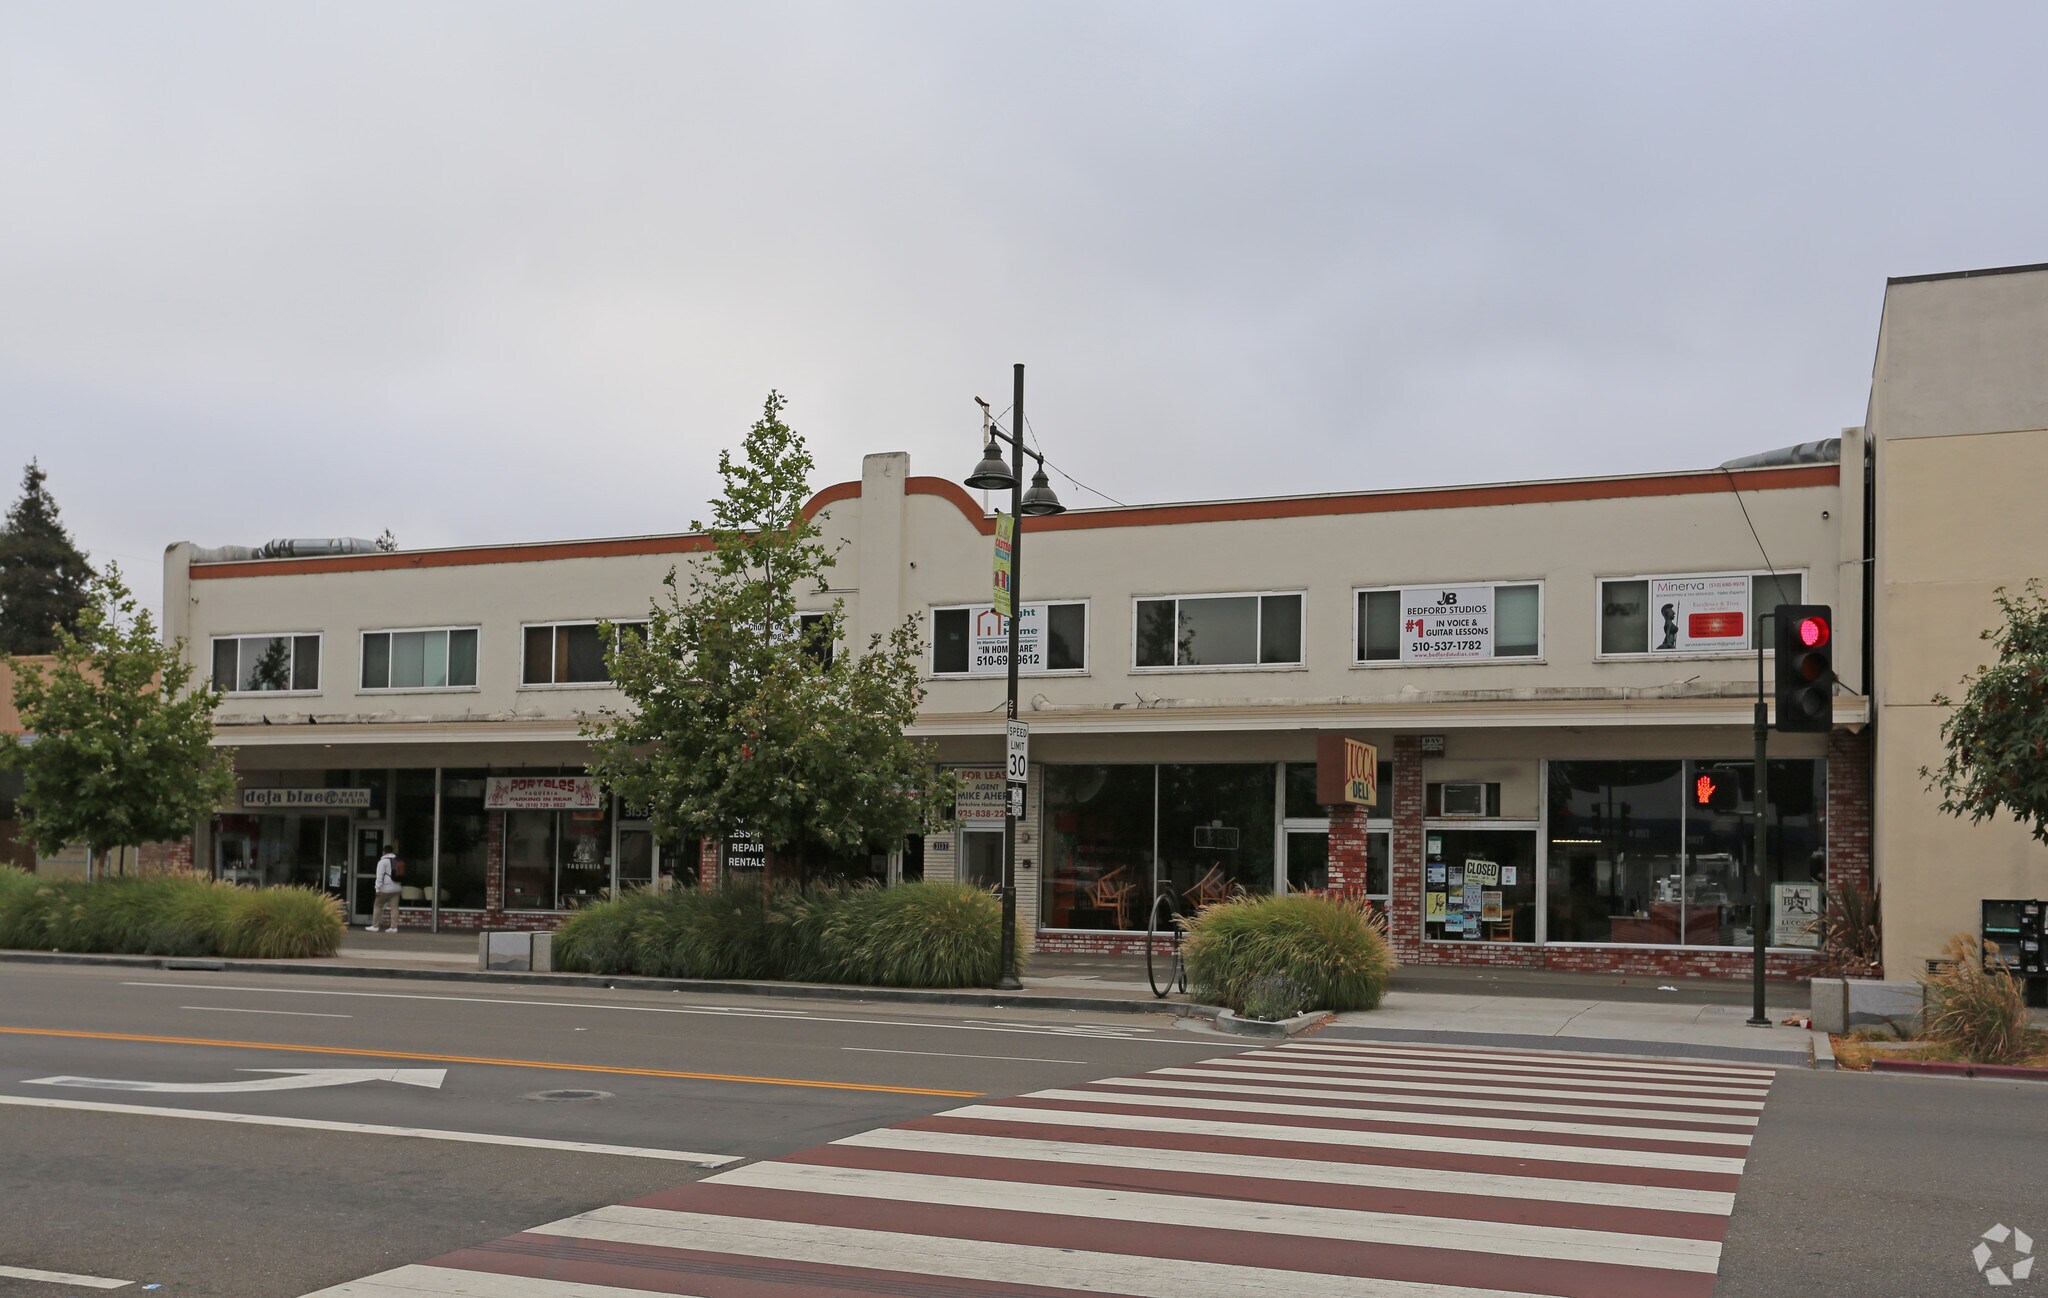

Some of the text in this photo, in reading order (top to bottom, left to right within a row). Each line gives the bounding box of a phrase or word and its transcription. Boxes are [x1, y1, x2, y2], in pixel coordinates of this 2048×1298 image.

[1657, 582, 1705, 592] Minerva
[1407, 605, 1487, 615] BEDFORD STUDIOS
[1405, 619, 1424, 638] #1
[1412, 641, 1482, 651] 510-537-1782
[1009, 727, 1027, 738] SPEED
[1010, 741, 1025, 751] LIMIT
[1009, 754, 1026, 777] 30
[1345, 742, 1376, 792] LUCCA
[962, 771, 1006, 780] FOR LEAS
[957, 792, 980, 800] MIKE
[1352, 781, 1369, 801] DELI
[246, 790, 282, 806] deja
[732, 844, 764, 852] REPAIR
[1467, 862, 1497, 877] CLOSED
[1783, 897, 1809, 906] BEST
